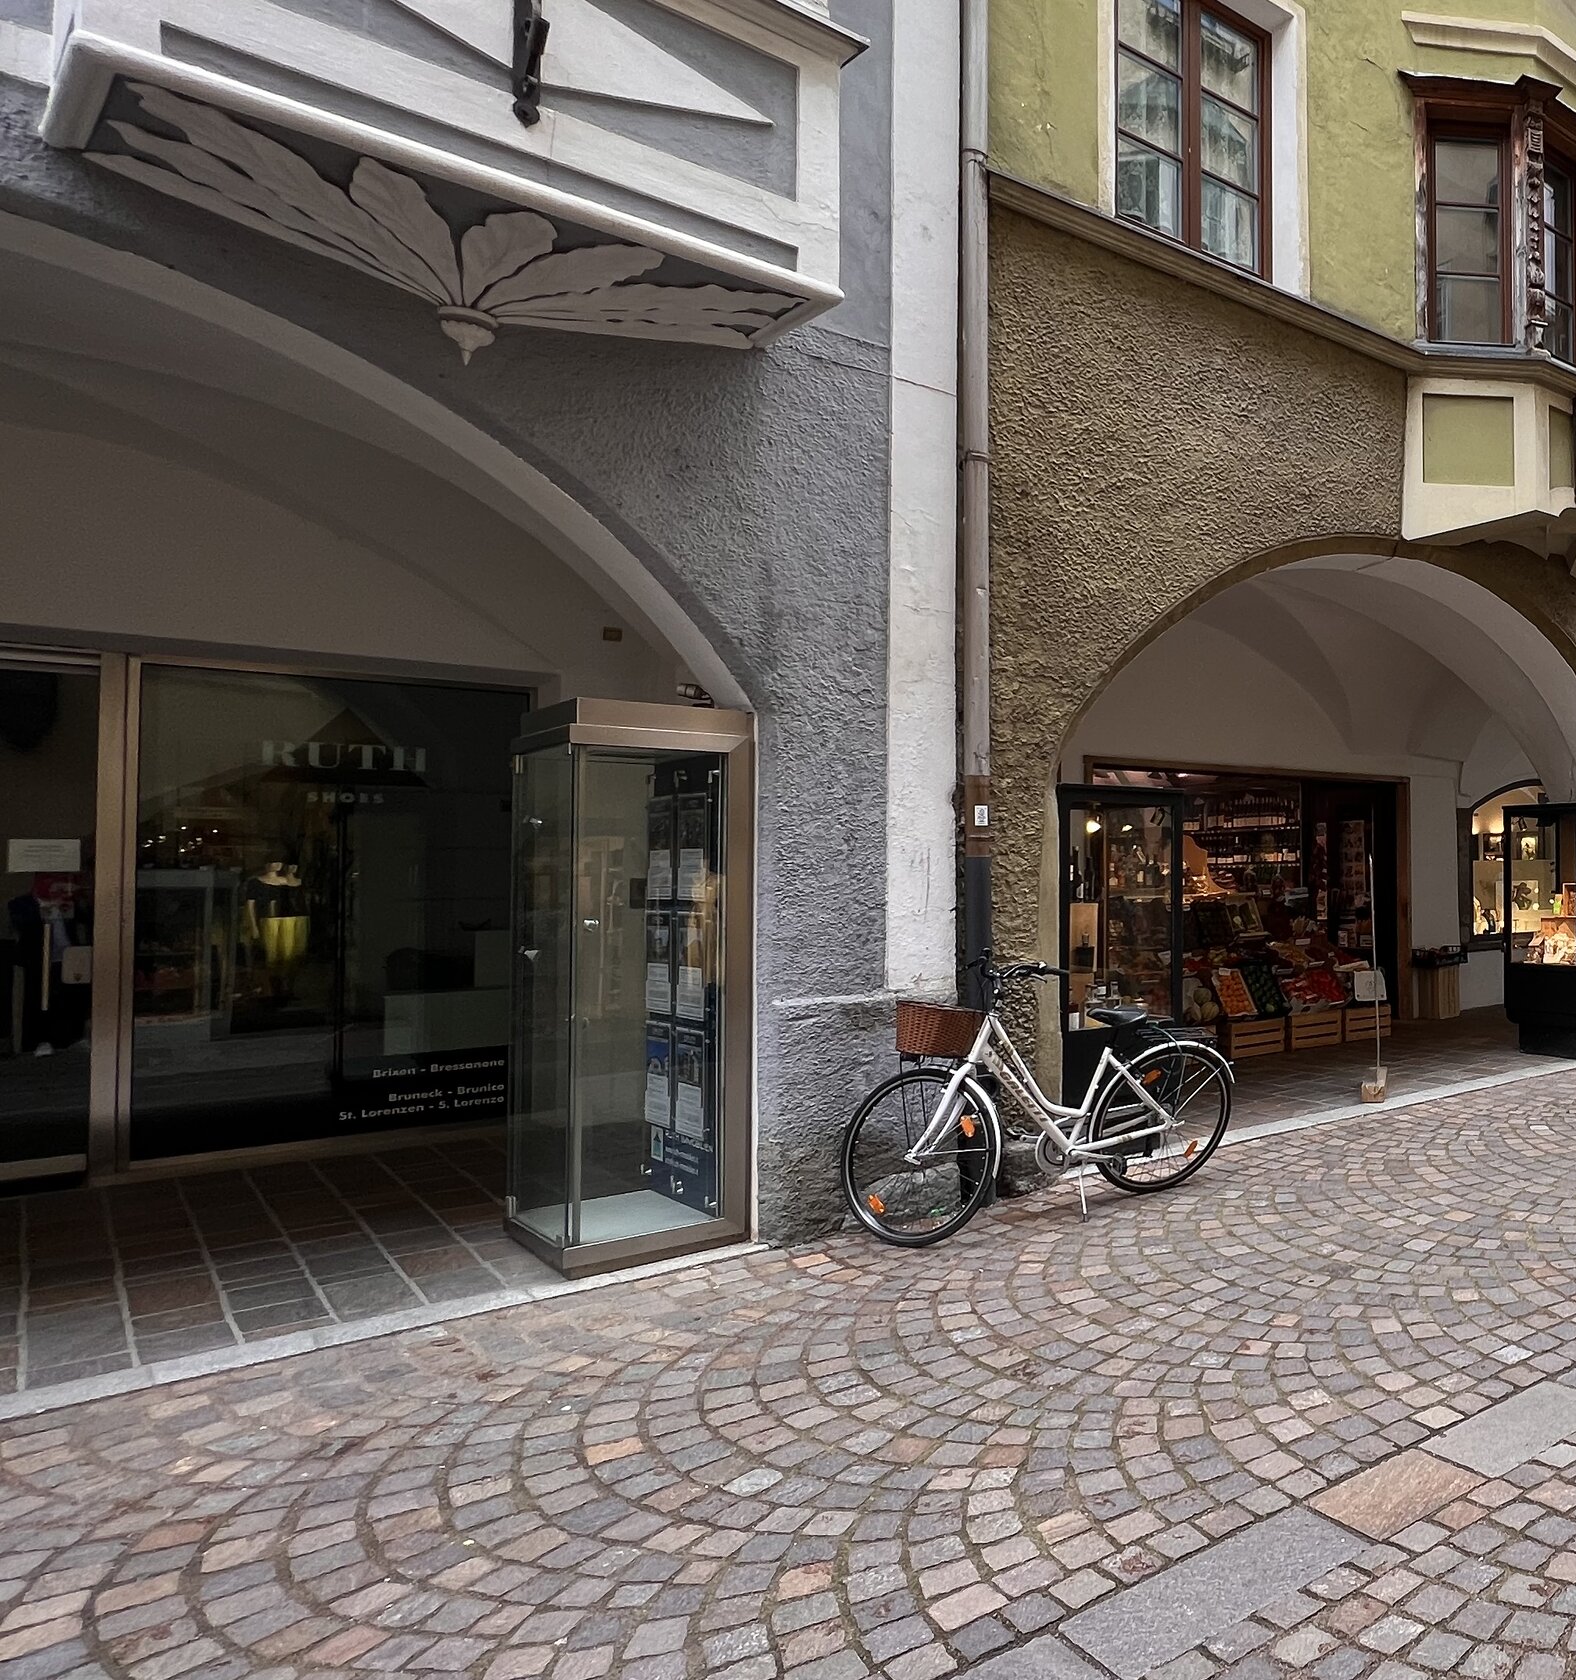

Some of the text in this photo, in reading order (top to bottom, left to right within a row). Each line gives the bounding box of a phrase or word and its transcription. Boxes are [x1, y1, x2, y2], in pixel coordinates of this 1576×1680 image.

[259, 740, 427, 772] RUTH
[307, 791, 384, 804] SHOES
[372, 1067, 416, 1078] Brixen
[430, 1059, 505, 1073] Bressanone
[388, 1089, 443, 1102] Bruneck
[457, 1083, 505, 1095] Brunico
[338, 1111, 357, 1121] St.
[361, 1104, 425, 1118] Lorenzen
[438, 1100, 450, 1110] S.
[454, 1095, 505, 1108] Lorenzo
